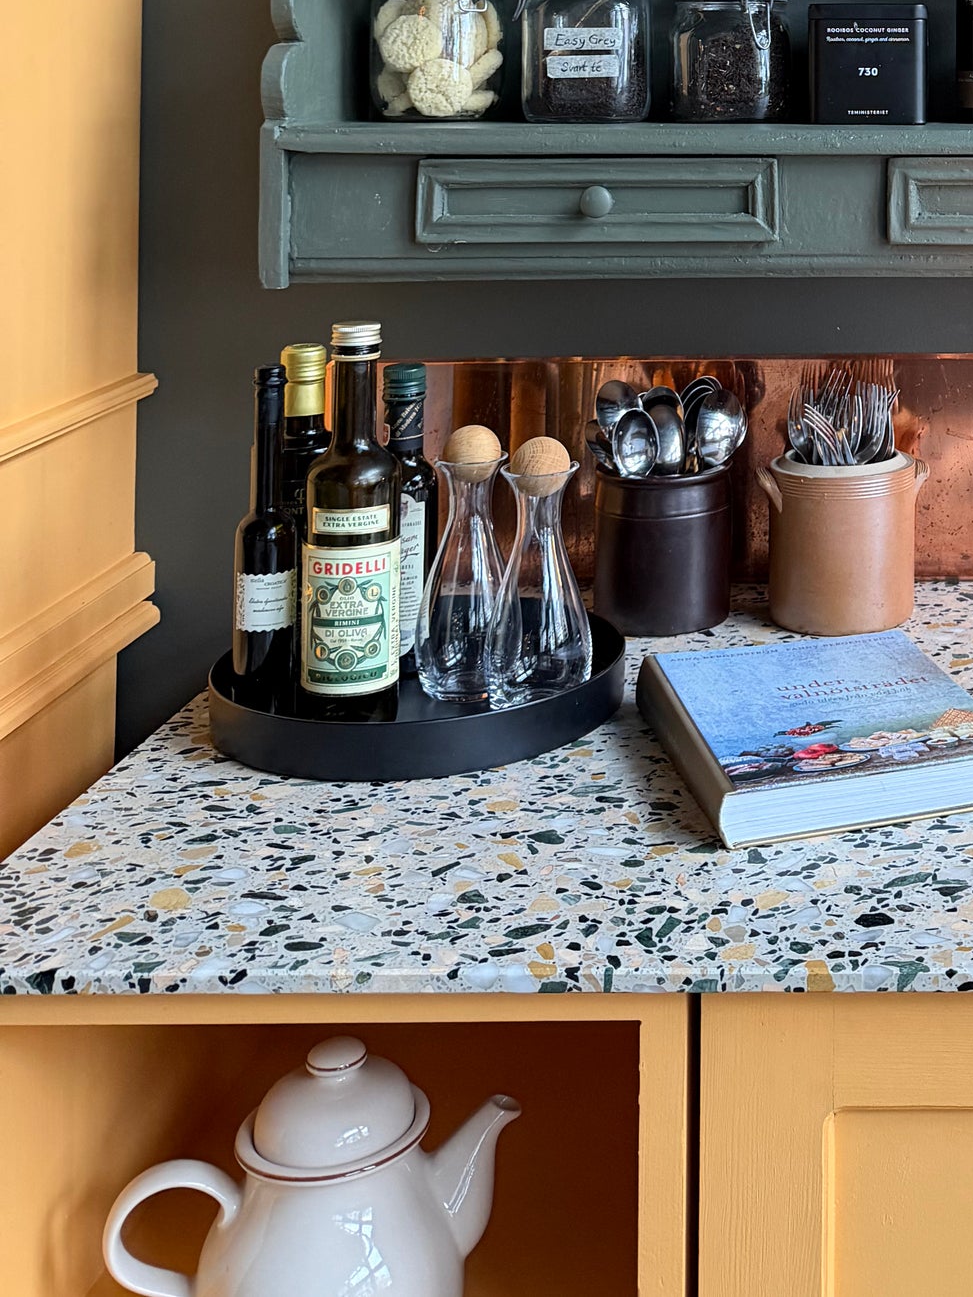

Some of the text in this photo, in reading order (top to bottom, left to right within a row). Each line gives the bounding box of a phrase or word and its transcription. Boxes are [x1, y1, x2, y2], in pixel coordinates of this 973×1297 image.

[554, 33, 616, 50] Easy Grey
[560, 60, 603, 73] Svart té
[858, 67, 879, 77] 730
[348, 520, 379, 528] VERGINE
[313, 558, 386, 575] GRIDELLI
[329, 600, 364, 610] EXTRA
[325, 607, 369, 617] VERGINE
[324, 628, 368, 638] DI OLIVA
[776, 678, 846, 692] under
[780, 675, 930, 700] valnötsträdet
